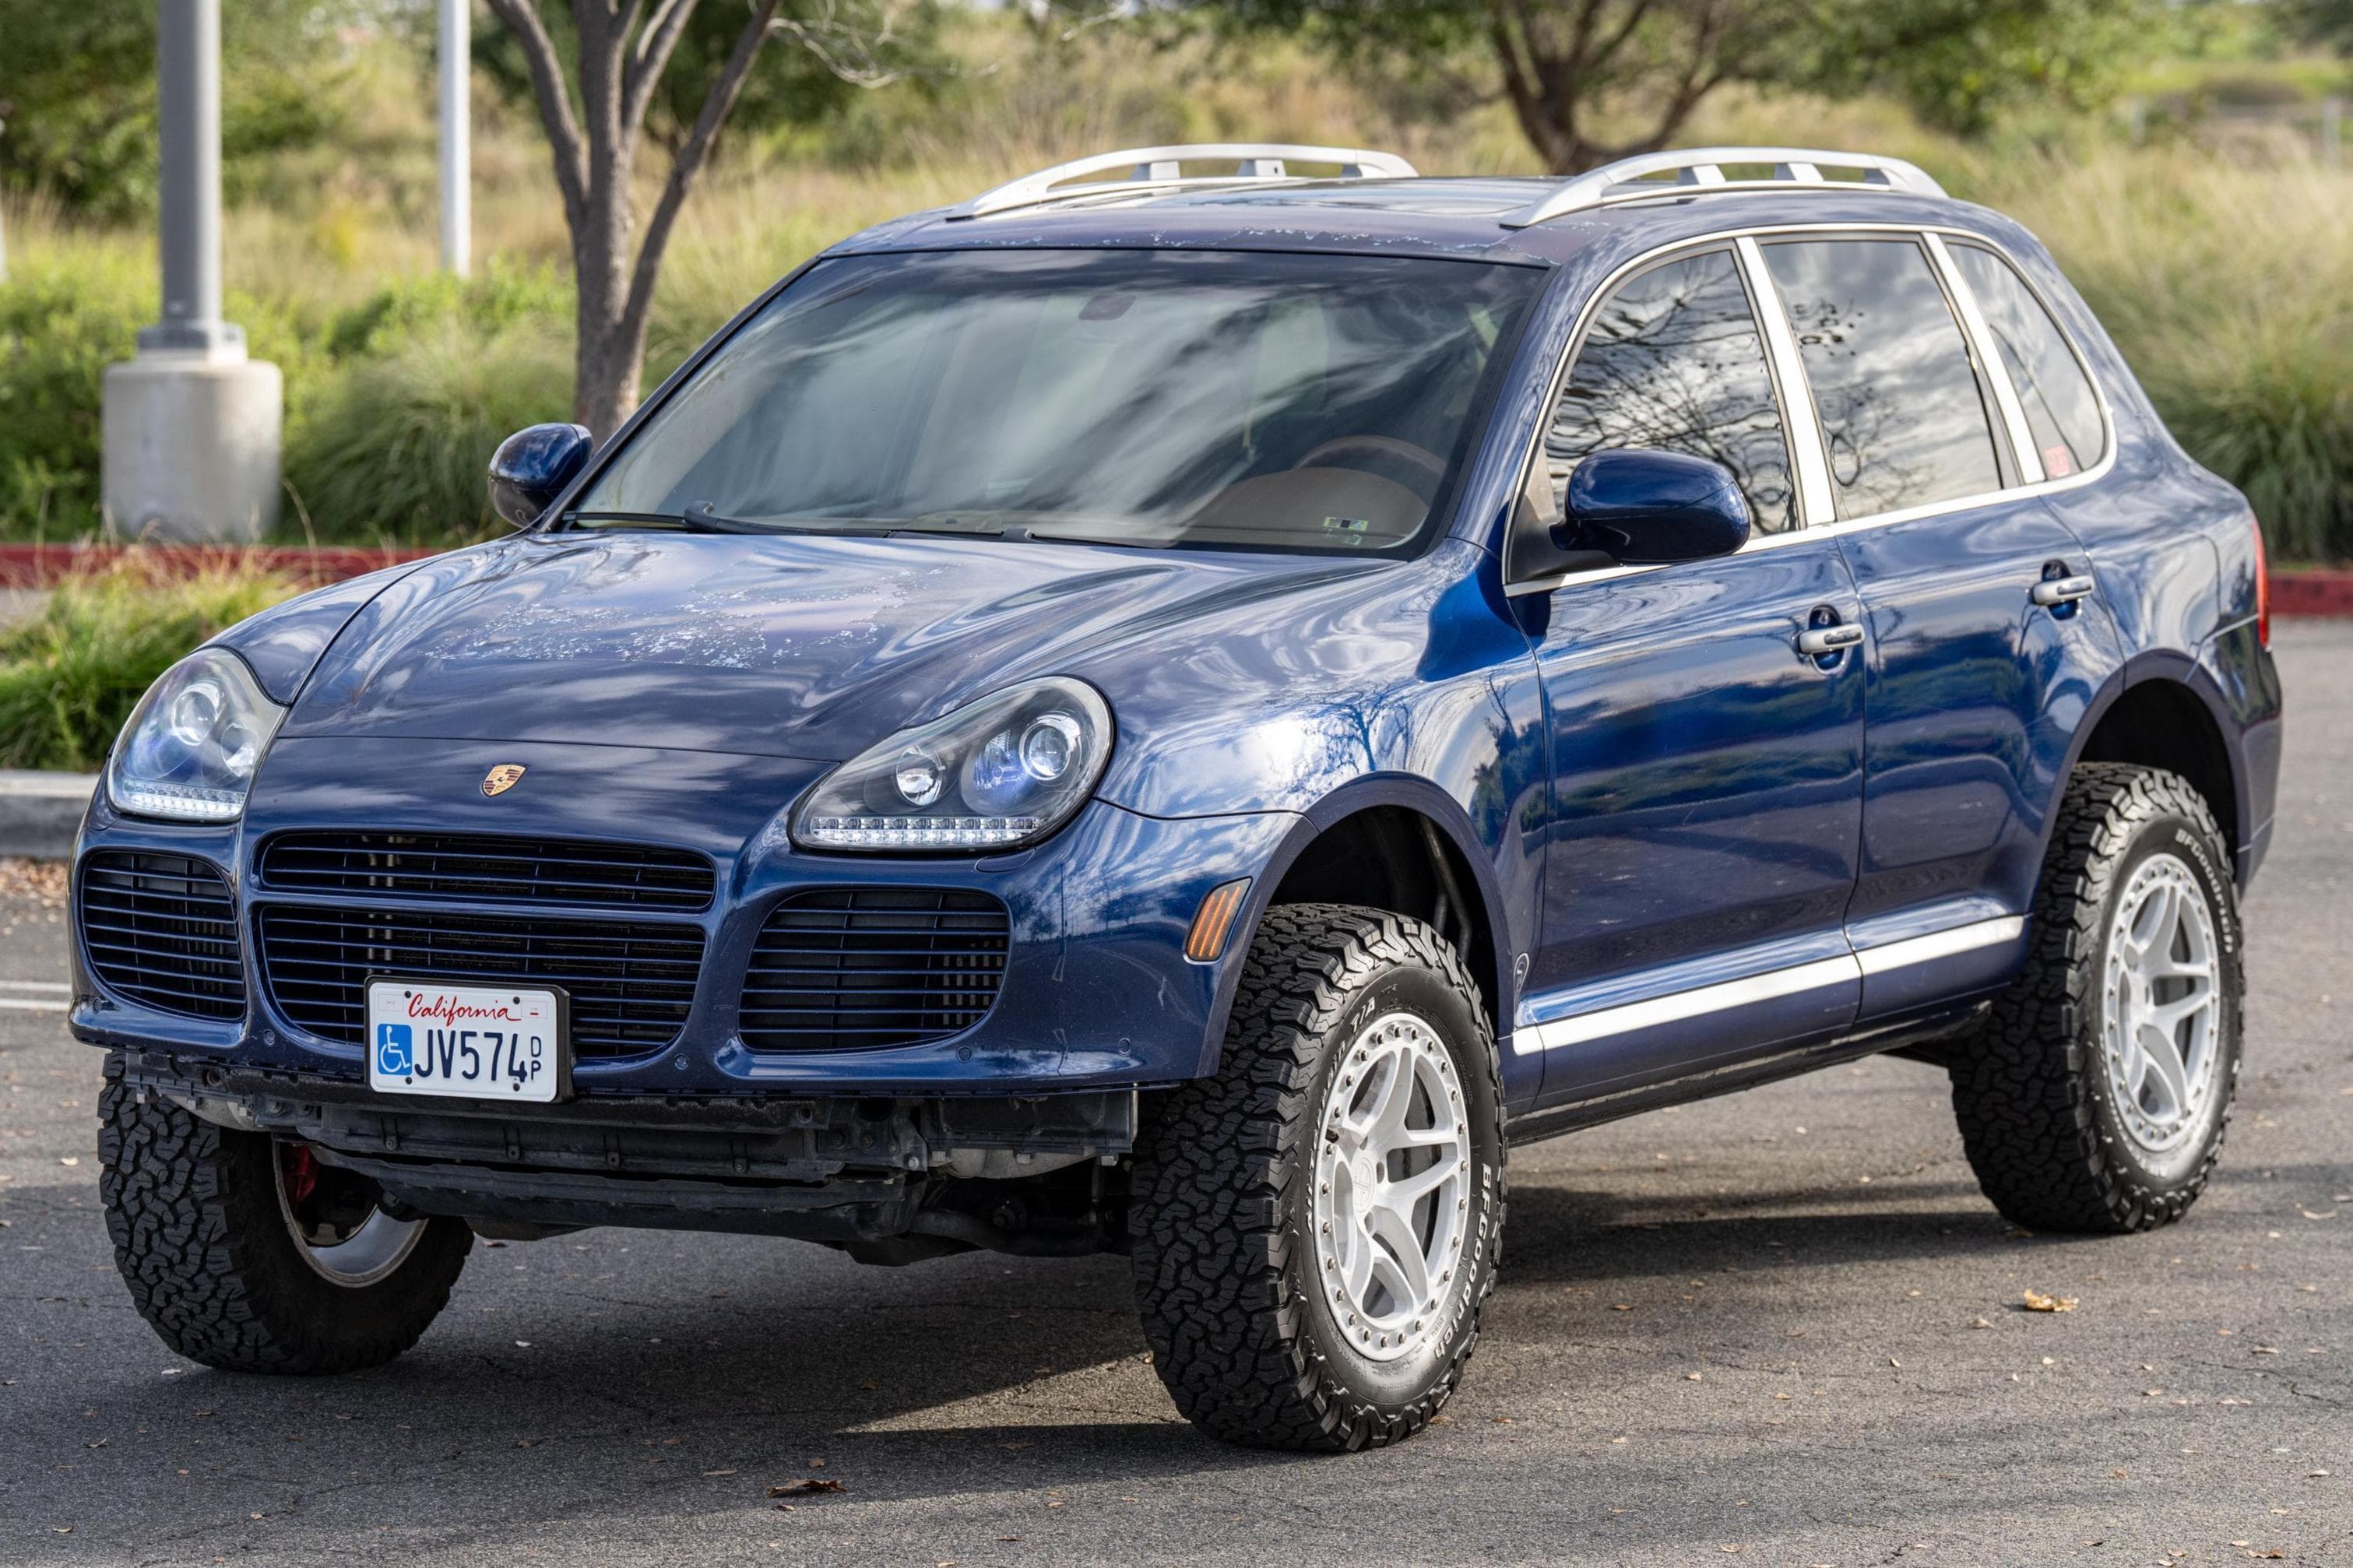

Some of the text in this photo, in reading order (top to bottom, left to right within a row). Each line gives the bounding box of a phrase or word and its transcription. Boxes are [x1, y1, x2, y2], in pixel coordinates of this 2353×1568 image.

[408, 993, 522, 1027] California
[1350, 997, 1376, 1034] T/A
[414, 1029, 528, 1083] JV574
[1434, 1164, 1492, 1359] BFGoodrich
